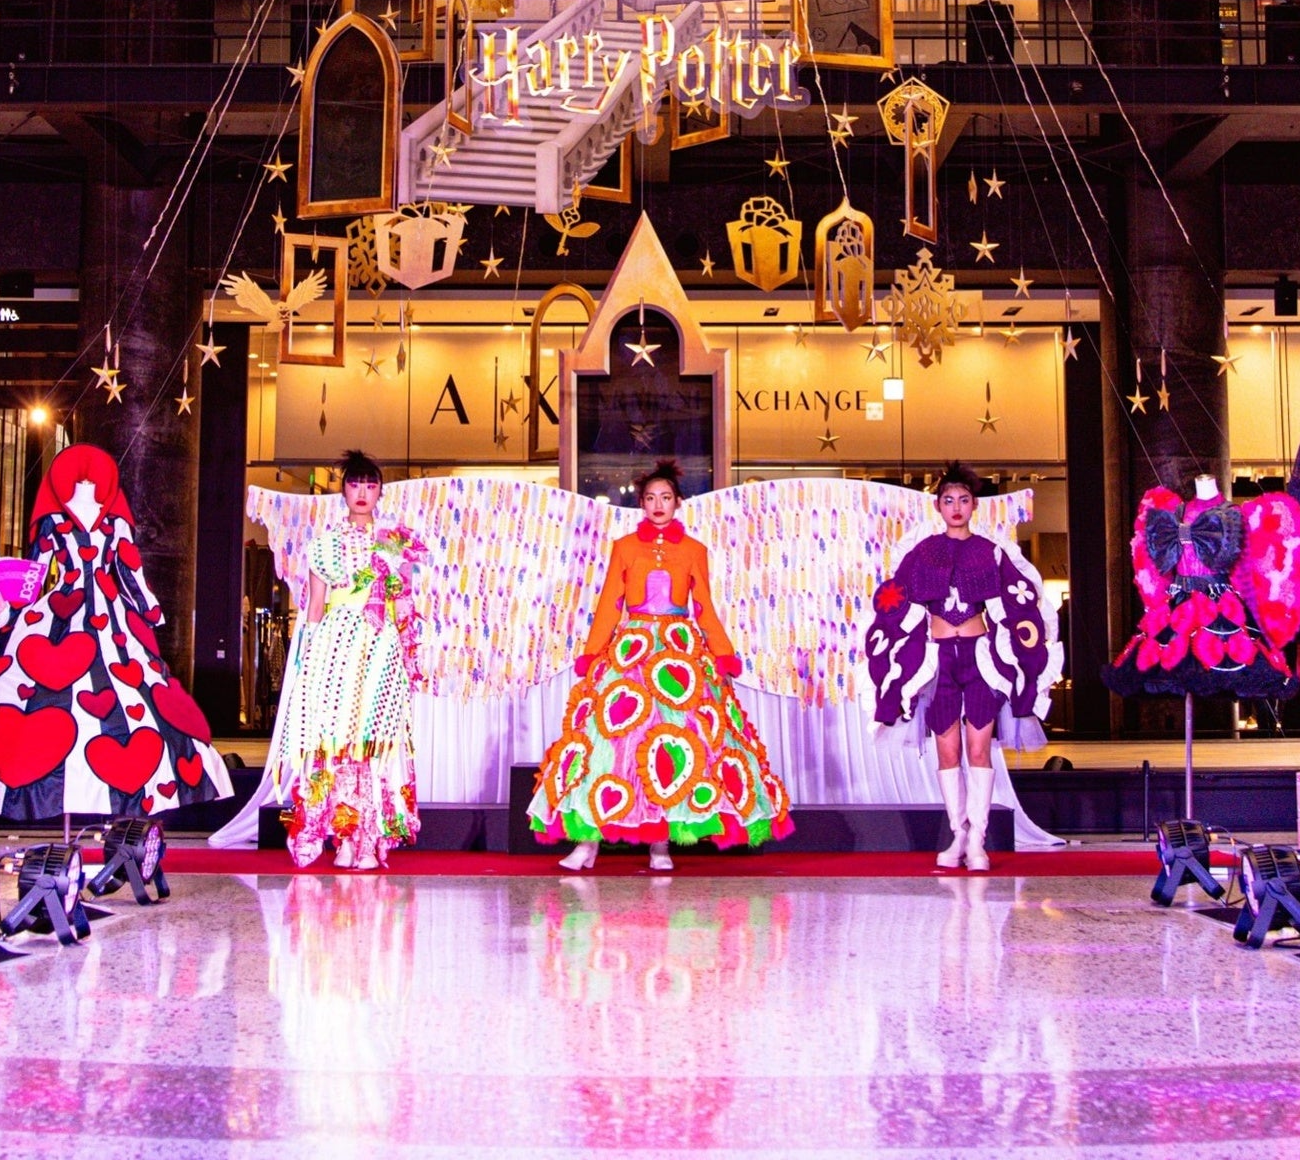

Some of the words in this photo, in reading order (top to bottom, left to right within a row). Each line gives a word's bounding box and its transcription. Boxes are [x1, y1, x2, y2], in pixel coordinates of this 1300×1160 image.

[468, 26, 632, 127] Harry
[636, 13, 802, 133] Potter
[736, 389, 868, 411] XCHANGE
